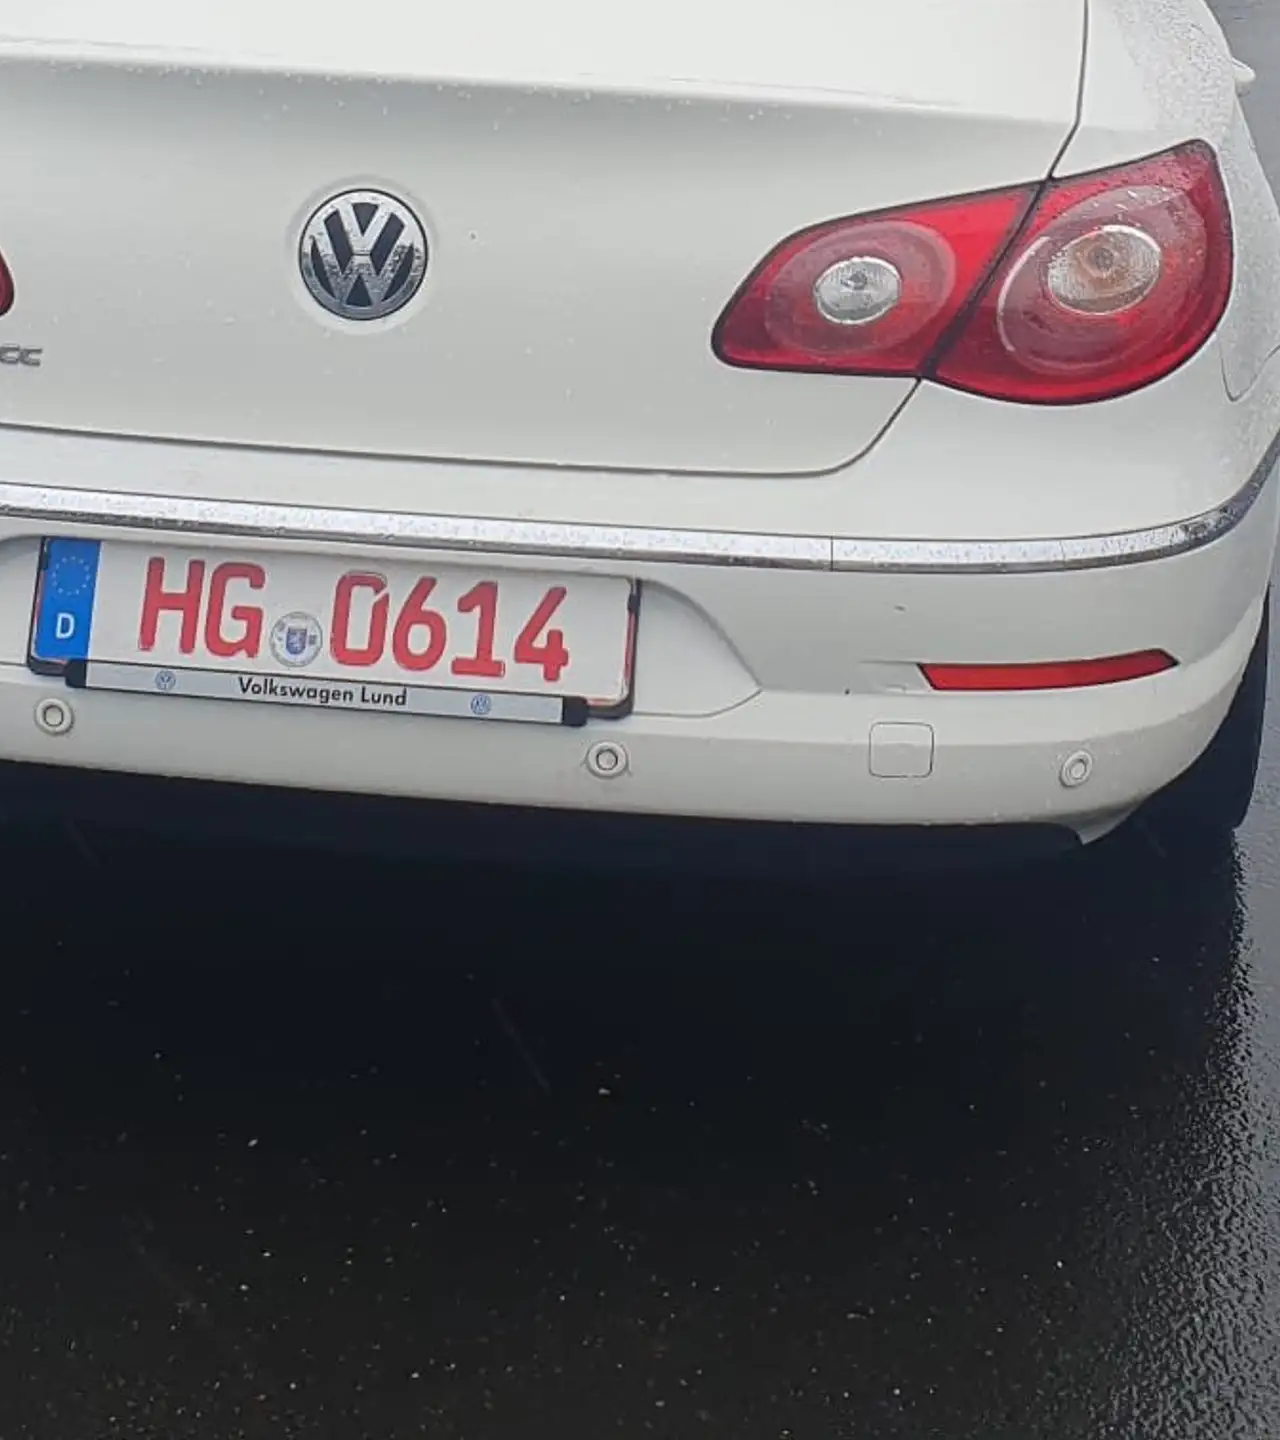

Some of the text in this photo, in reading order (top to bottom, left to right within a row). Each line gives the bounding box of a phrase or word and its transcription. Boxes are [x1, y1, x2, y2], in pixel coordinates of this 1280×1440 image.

[301, 191, 426, 318] VW
[56, 612, 75, 639] D
[140, 558, 570, 681] HG 0614
[238, 676, 408, 707] Volkswagen Lund
